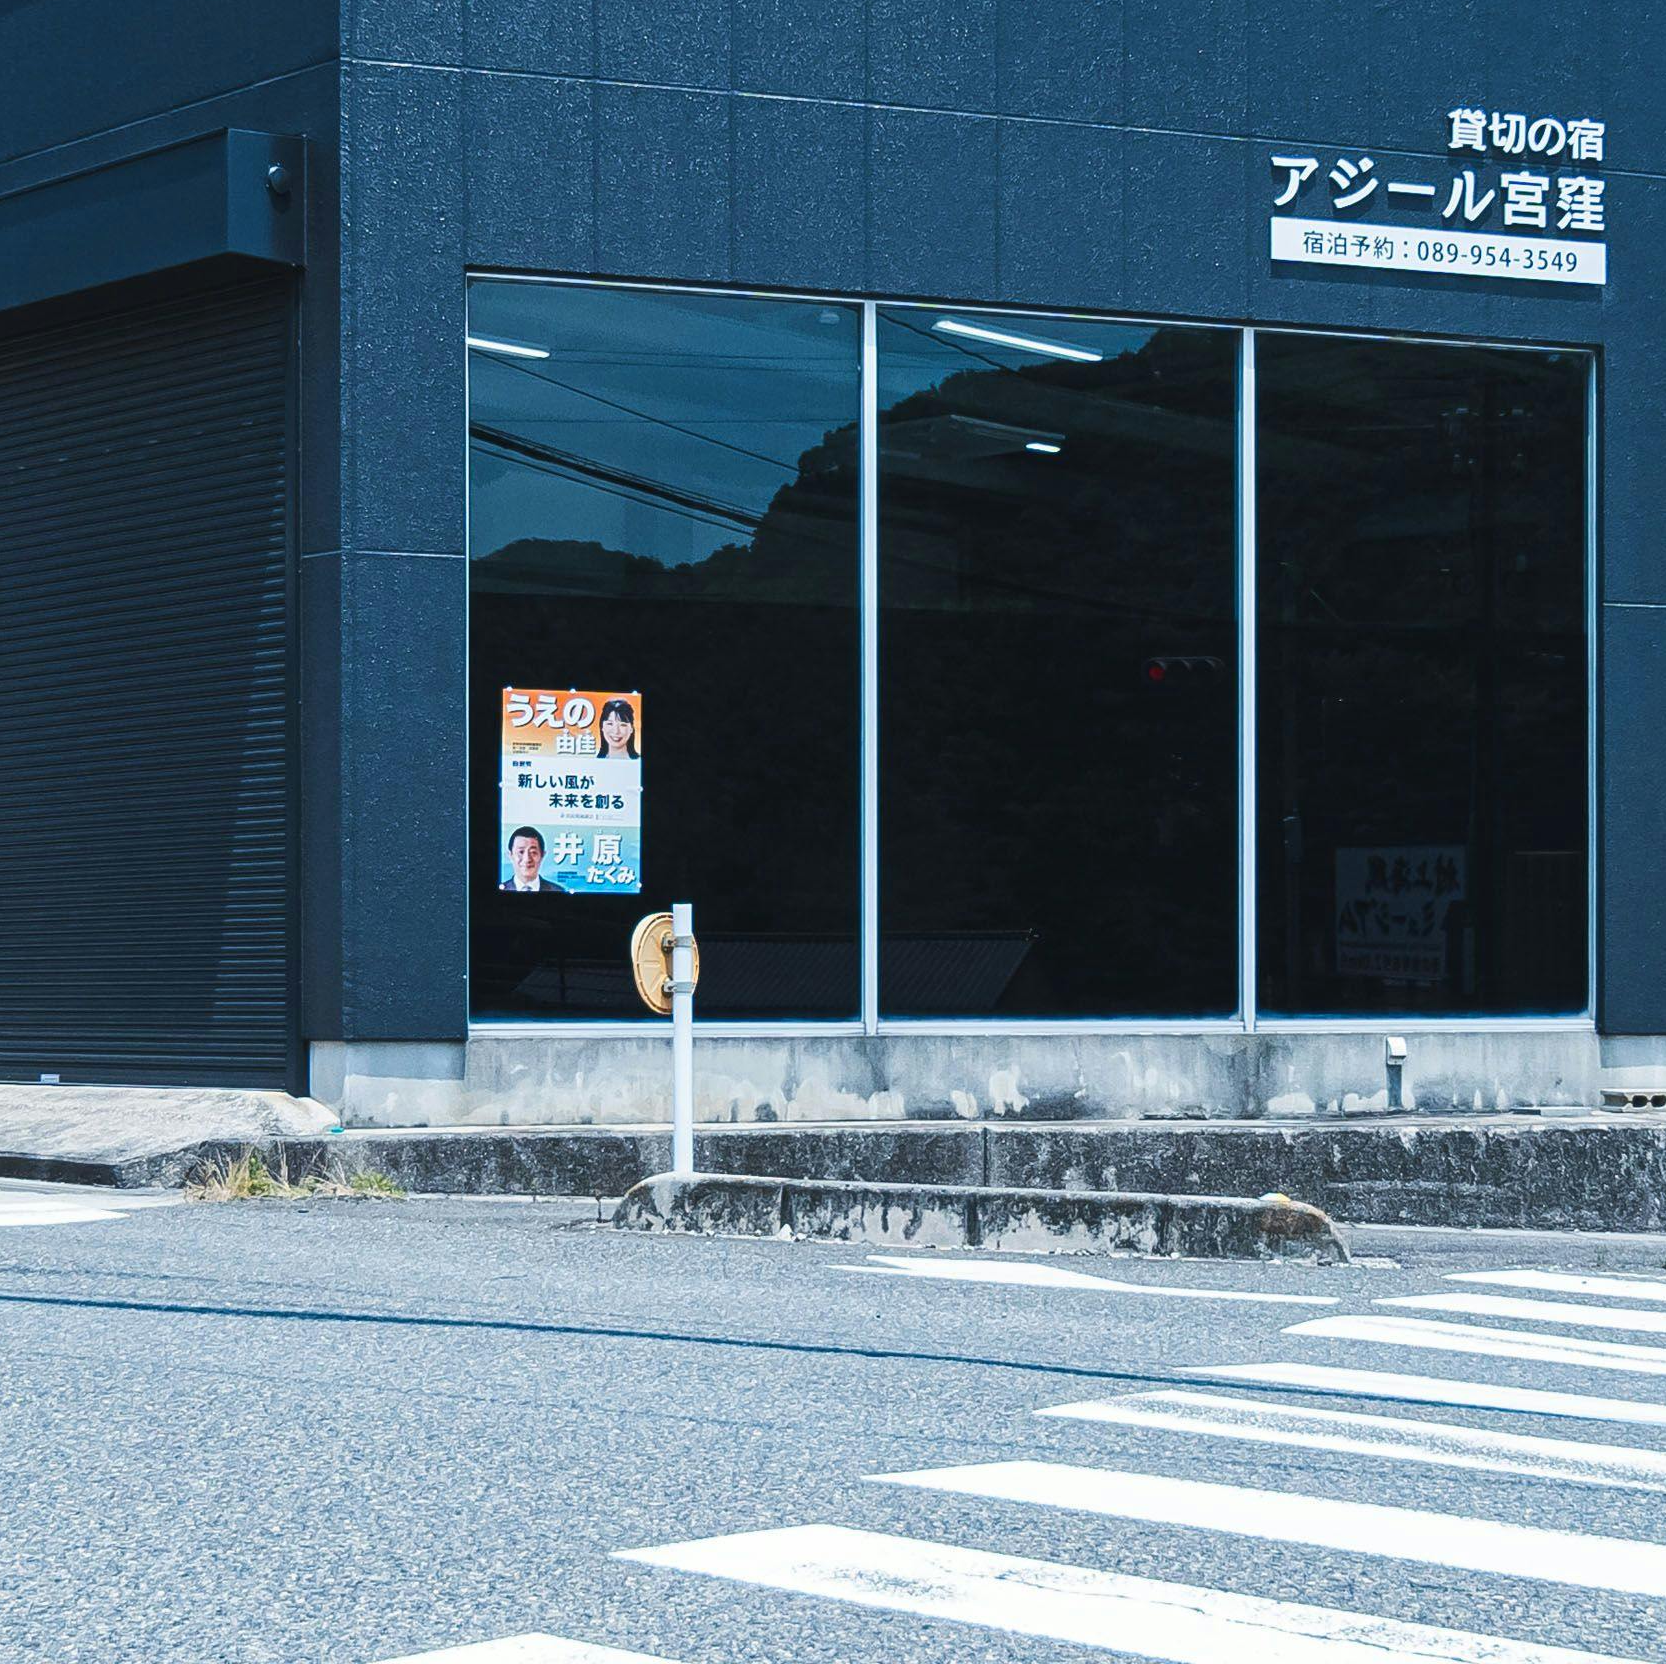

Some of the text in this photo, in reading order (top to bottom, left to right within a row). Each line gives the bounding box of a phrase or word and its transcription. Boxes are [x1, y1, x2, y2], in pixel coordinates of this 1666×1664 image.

[1447, 108, 1605, 161] 貸切の宿
[1271, 156, 1605, 231] アジール宮窪
[506, 694, 595, 729] うえの
[517, 773, 595, 790] 新しい風が
[549, 793, 625, 809] 未来を創る
